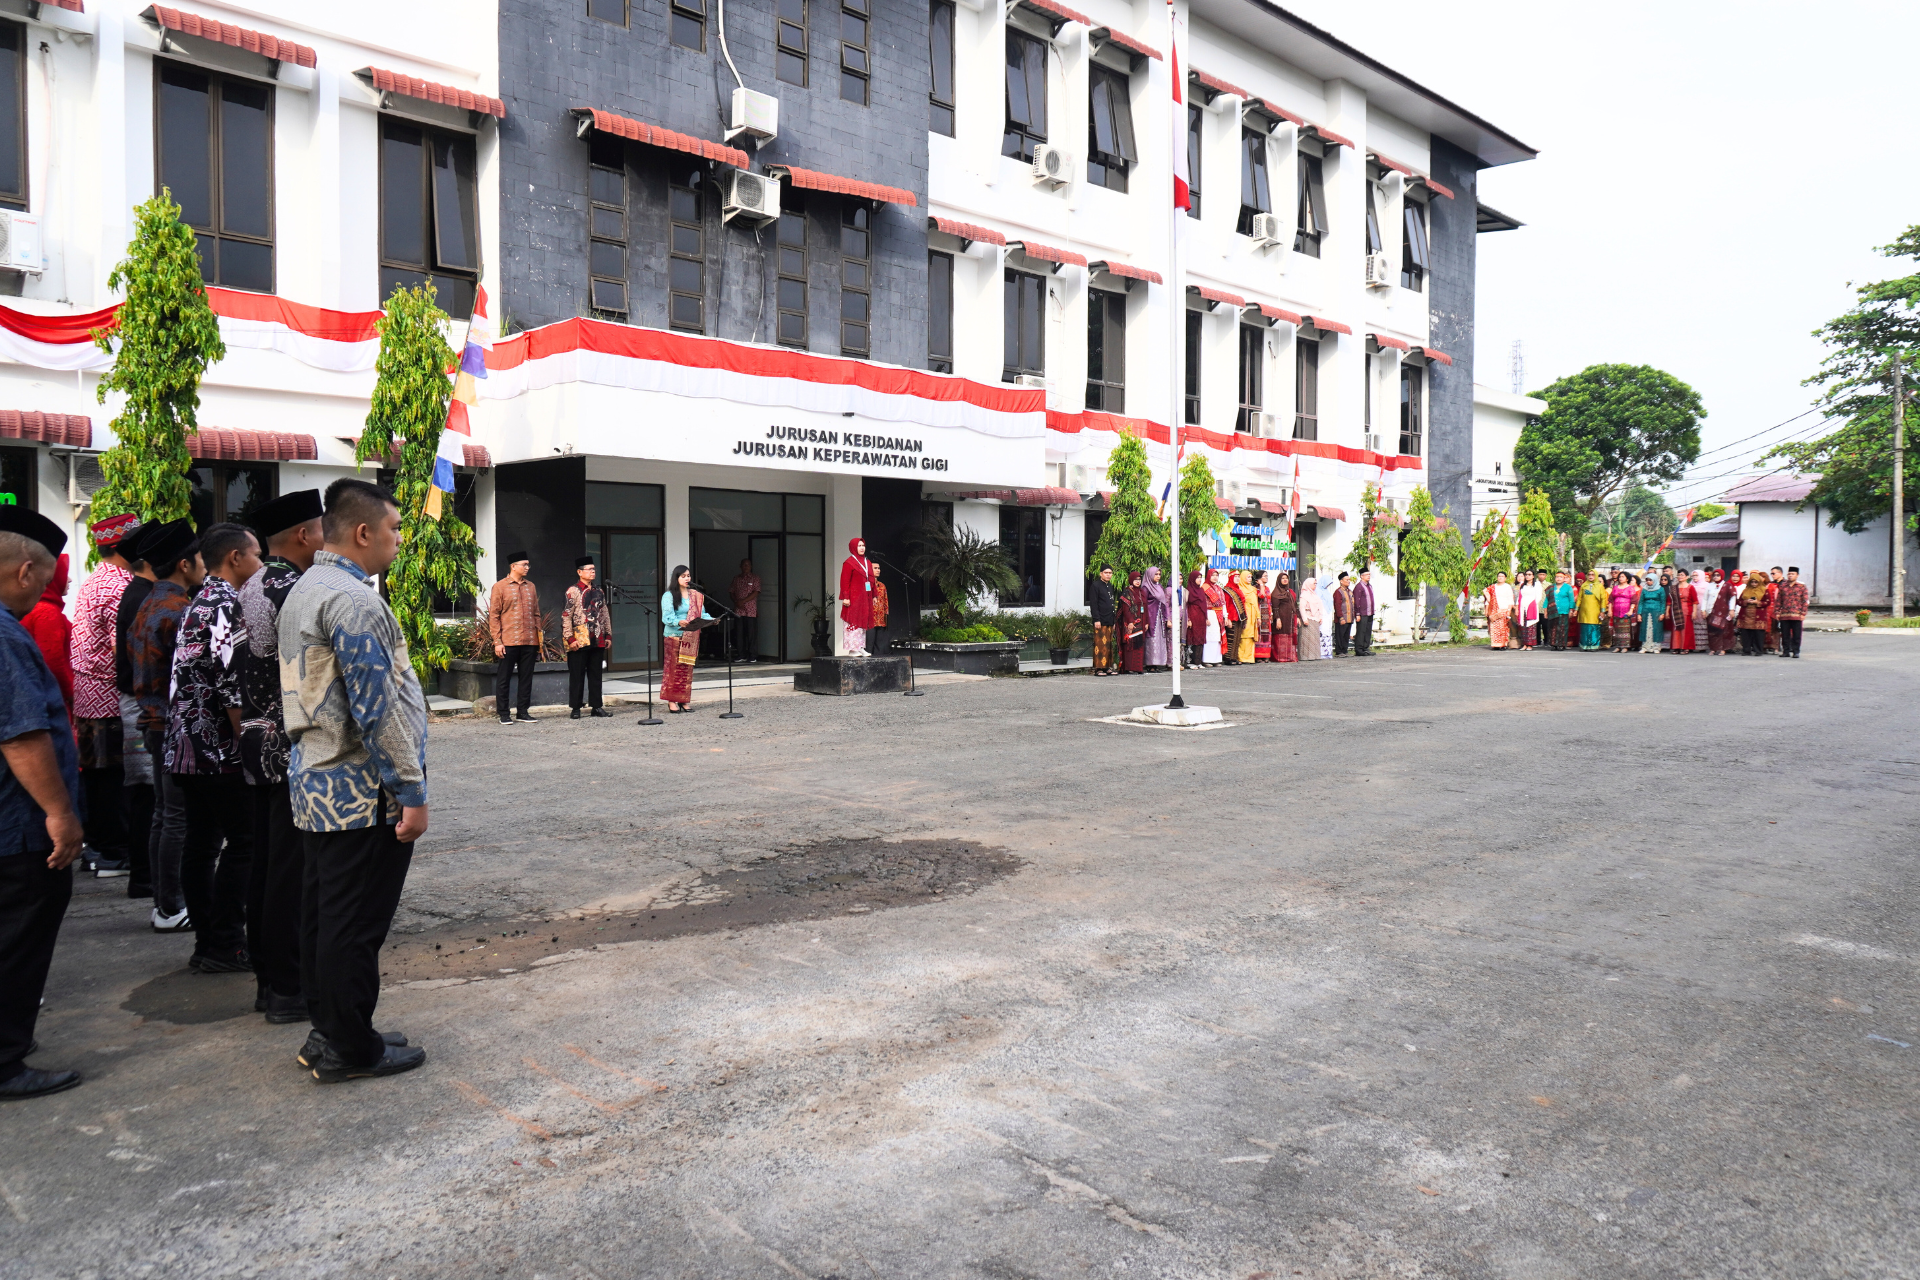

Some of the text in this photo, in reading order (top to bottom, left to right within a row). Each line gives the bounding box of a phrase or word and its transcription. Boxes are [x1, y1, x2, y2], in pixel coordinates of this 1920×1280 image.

[766, 425, 923, 452] JURUSAN KEBIDANAN
[732, 441, 948, 471] JURUSAN KEPERAWATAN GIGI
[1231, 522, 1274, 535] Kemenkes
[1231, 537, 1297, 551] Poltekkes Medan
[1208, 555, 1297, 570] JURUSAN KEBIDANAN
